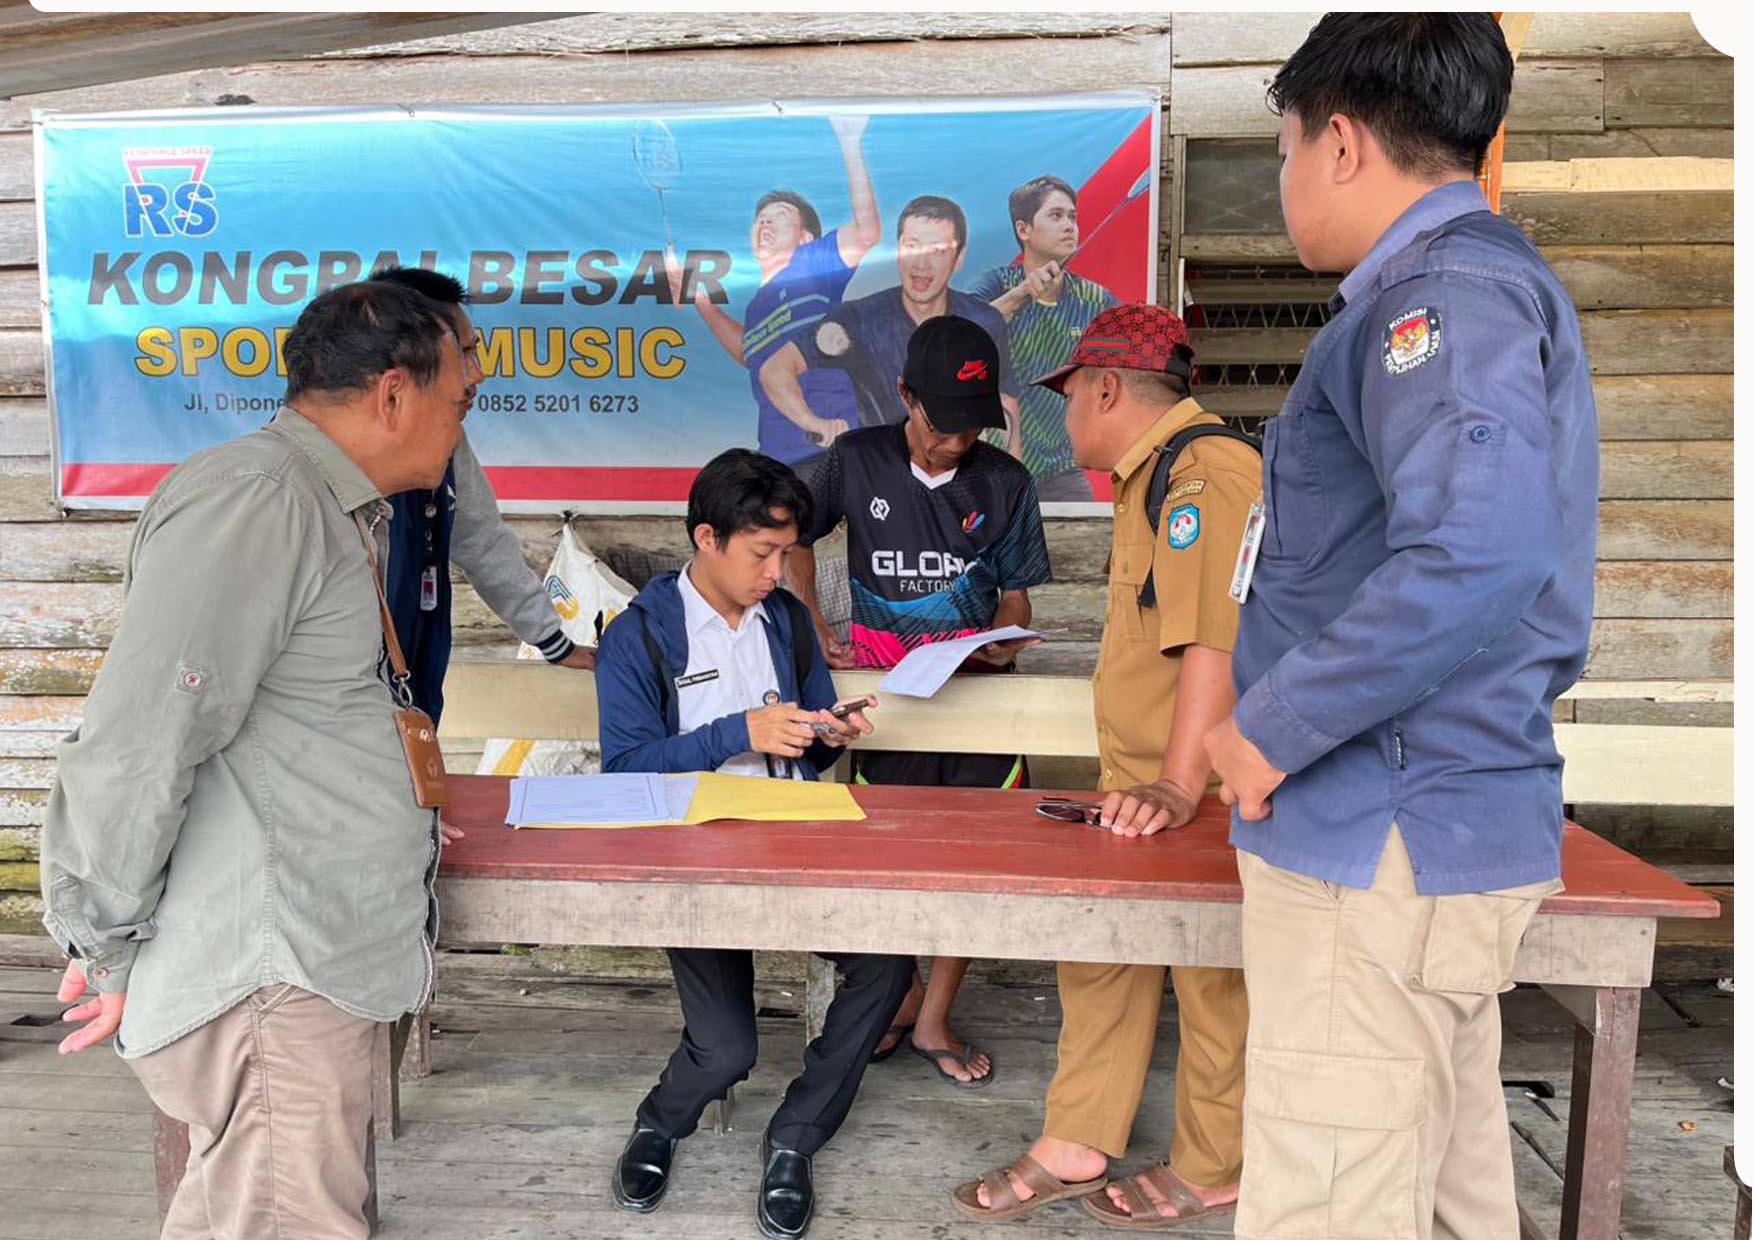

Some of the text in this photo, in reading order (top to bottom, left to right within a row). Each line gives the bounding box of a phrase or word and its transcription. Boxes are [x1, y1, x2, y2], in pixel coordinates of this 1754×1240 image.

[123, 182, 219, 237] RS
[466, 250, 733, 305] BESAR
[1388, 307, 1427, 330] KOMISI
[134, 327, 289, 377] SPO
[474, 327, 687, 379] MUSIC
[478, 394, 526, 412] 0852
[534, 394, 580, 412] 5201
[589, 394, 639, 412] 6273
